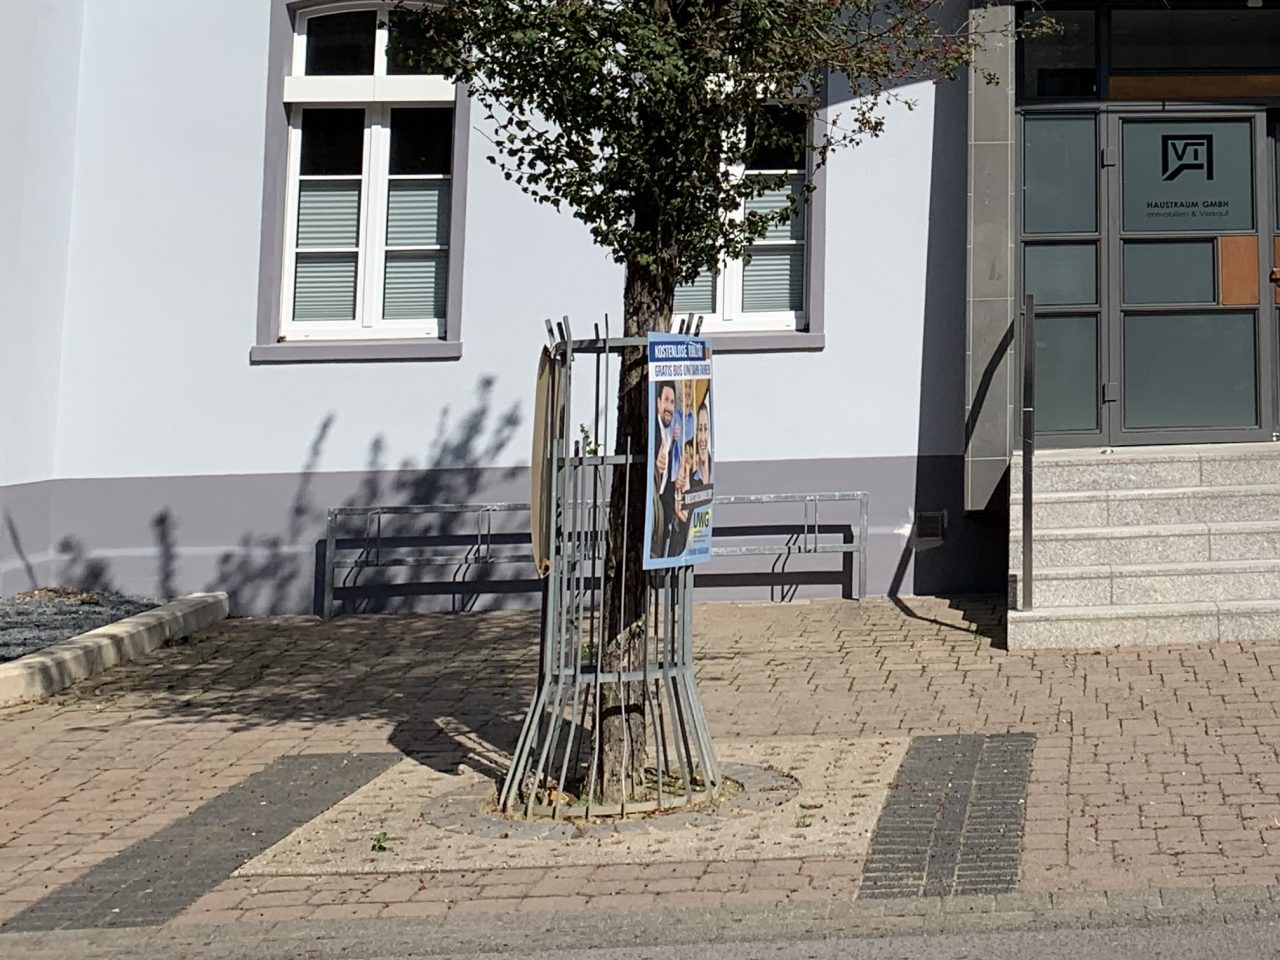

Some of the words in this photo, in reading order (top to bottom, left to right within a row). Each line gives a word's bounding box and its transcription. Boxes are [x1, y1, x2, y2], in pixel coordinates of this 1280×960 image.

[1146, 201, 1199, 209] HAUSTRAUM
[1202, 200, 1229, 208] GMBH
[1146, 210, 1189, 218] Immobilien
[655, 344, 687, 358] KOSTENLOSE
[655, 364, 673, 377] GRATIS
[693, 511, 710, 528] UWG
